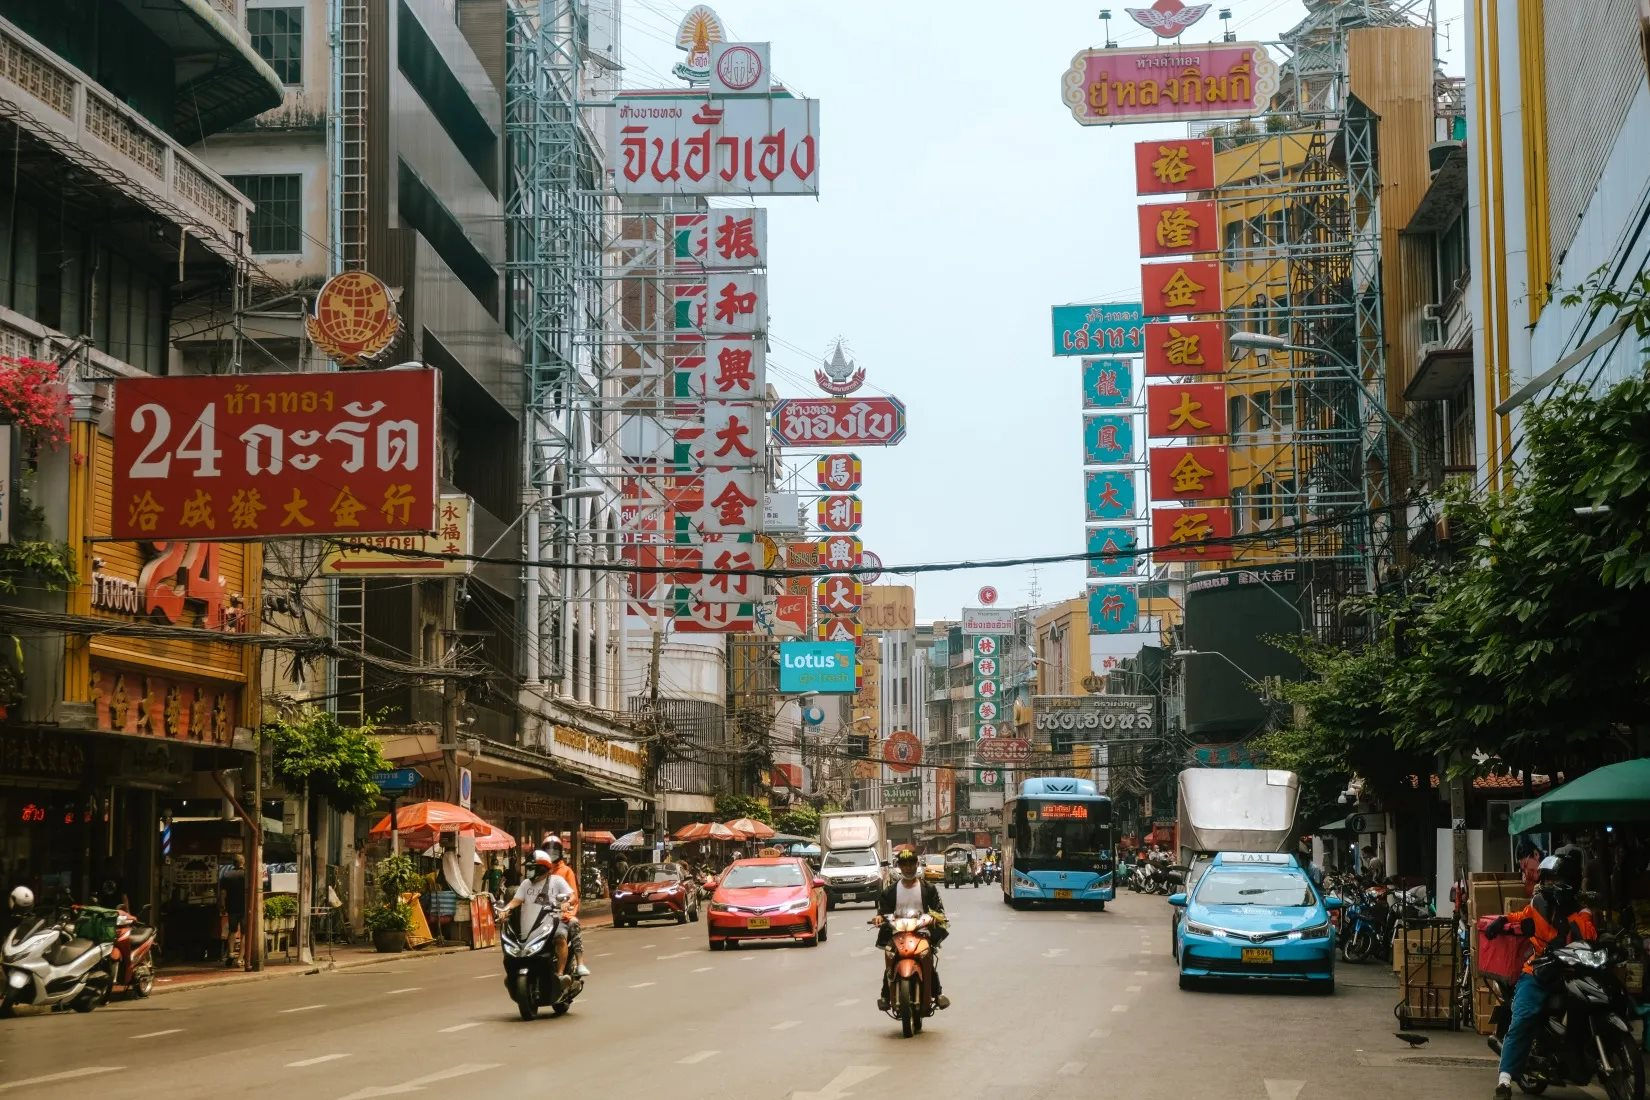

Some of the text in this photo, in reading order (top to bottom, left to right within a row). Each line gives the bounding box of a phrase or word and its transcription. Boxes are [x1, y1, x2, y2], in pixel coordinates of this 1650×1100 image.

[1135, 53, 1201, 69] ห้างค้าทอง
[1089, 53, 1250, 116] ยู่หลงกิมกี่
[620, 105, 683, 119] ห้างขายทอง
[1086, 308, 1138, 323] ห้างทอง
[225, 384, 334, 415] ห้างทอง
[786, 403, 837, 415] ห้างทอง
[784, 402, 893, 440] ทองใบ
[129, 400, 419, 478] 24 กะรัต
[779, 603, 800, 615] KFC
[408, 772, 416, 783] 8
[1240, 853, 1271, 862] TAXI
[526, 887, 554, 896] GUI
